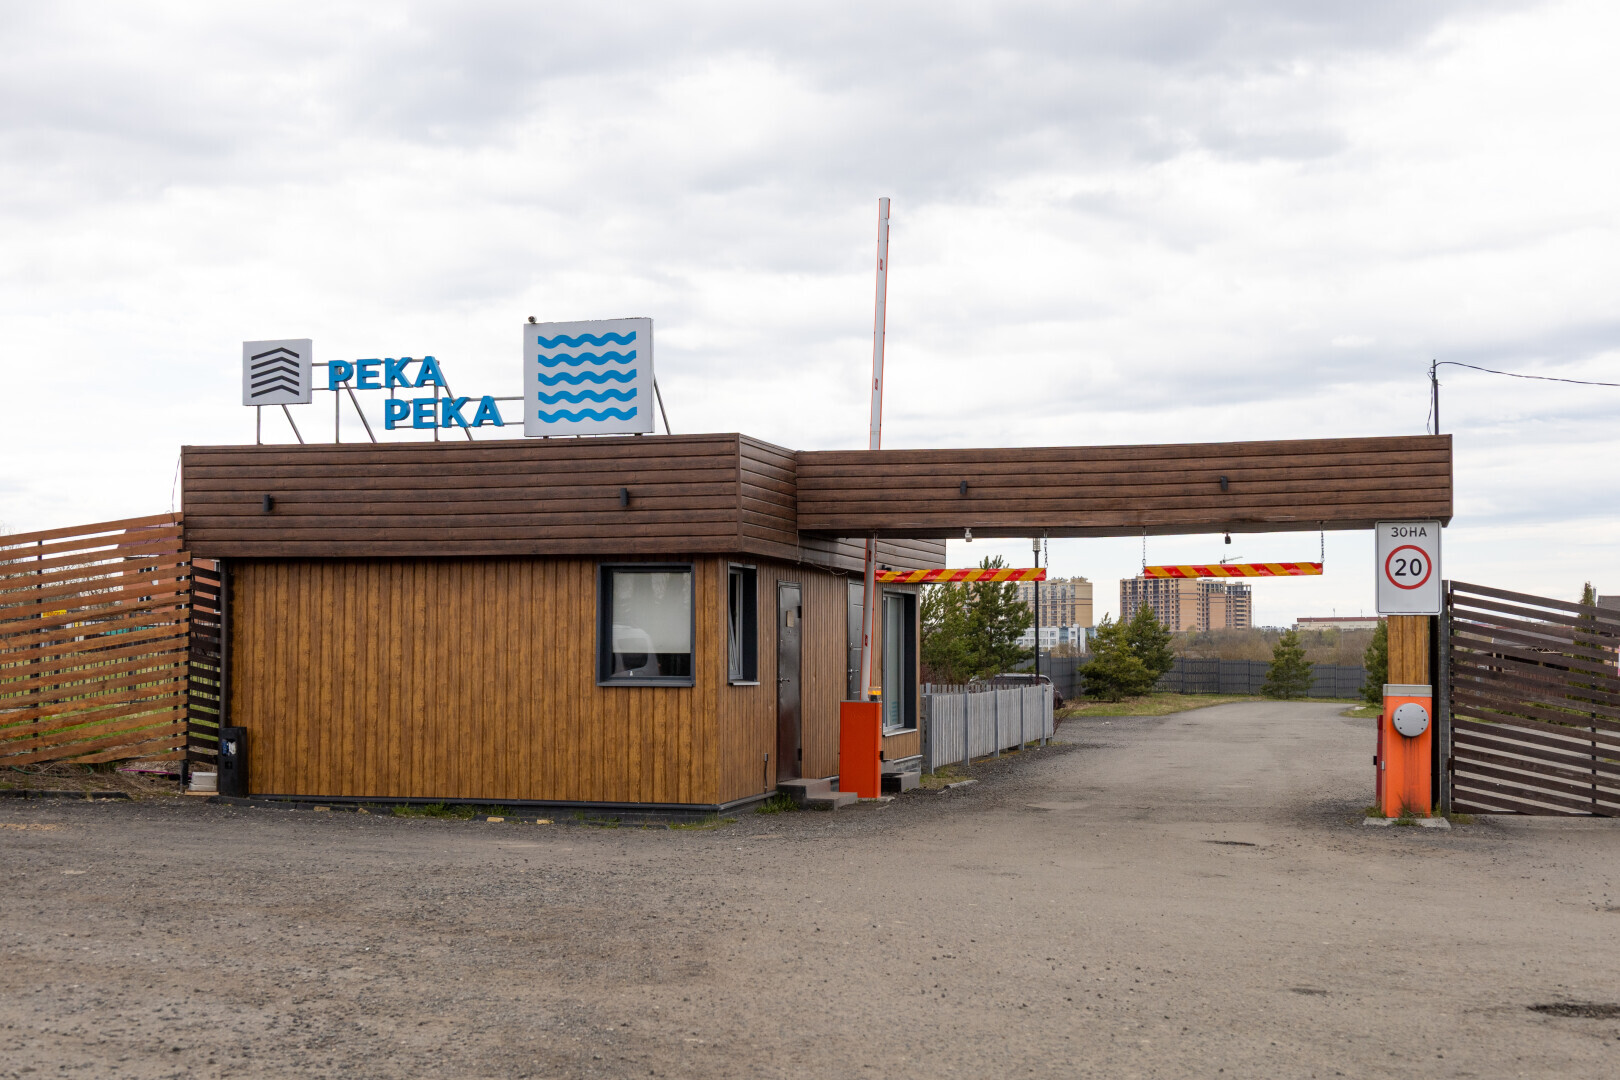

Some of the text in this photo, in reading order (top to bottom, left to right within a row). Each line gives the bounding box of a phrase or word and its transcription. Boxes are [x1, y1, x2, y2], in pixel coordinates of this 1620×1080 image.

[328, 356, 445, 391] РЕКА
[384, 396, 504, 430] РЕКА
[1391, 526, 1427, 537] ЗОНА
[1395, 558, 1422, 576] 20
